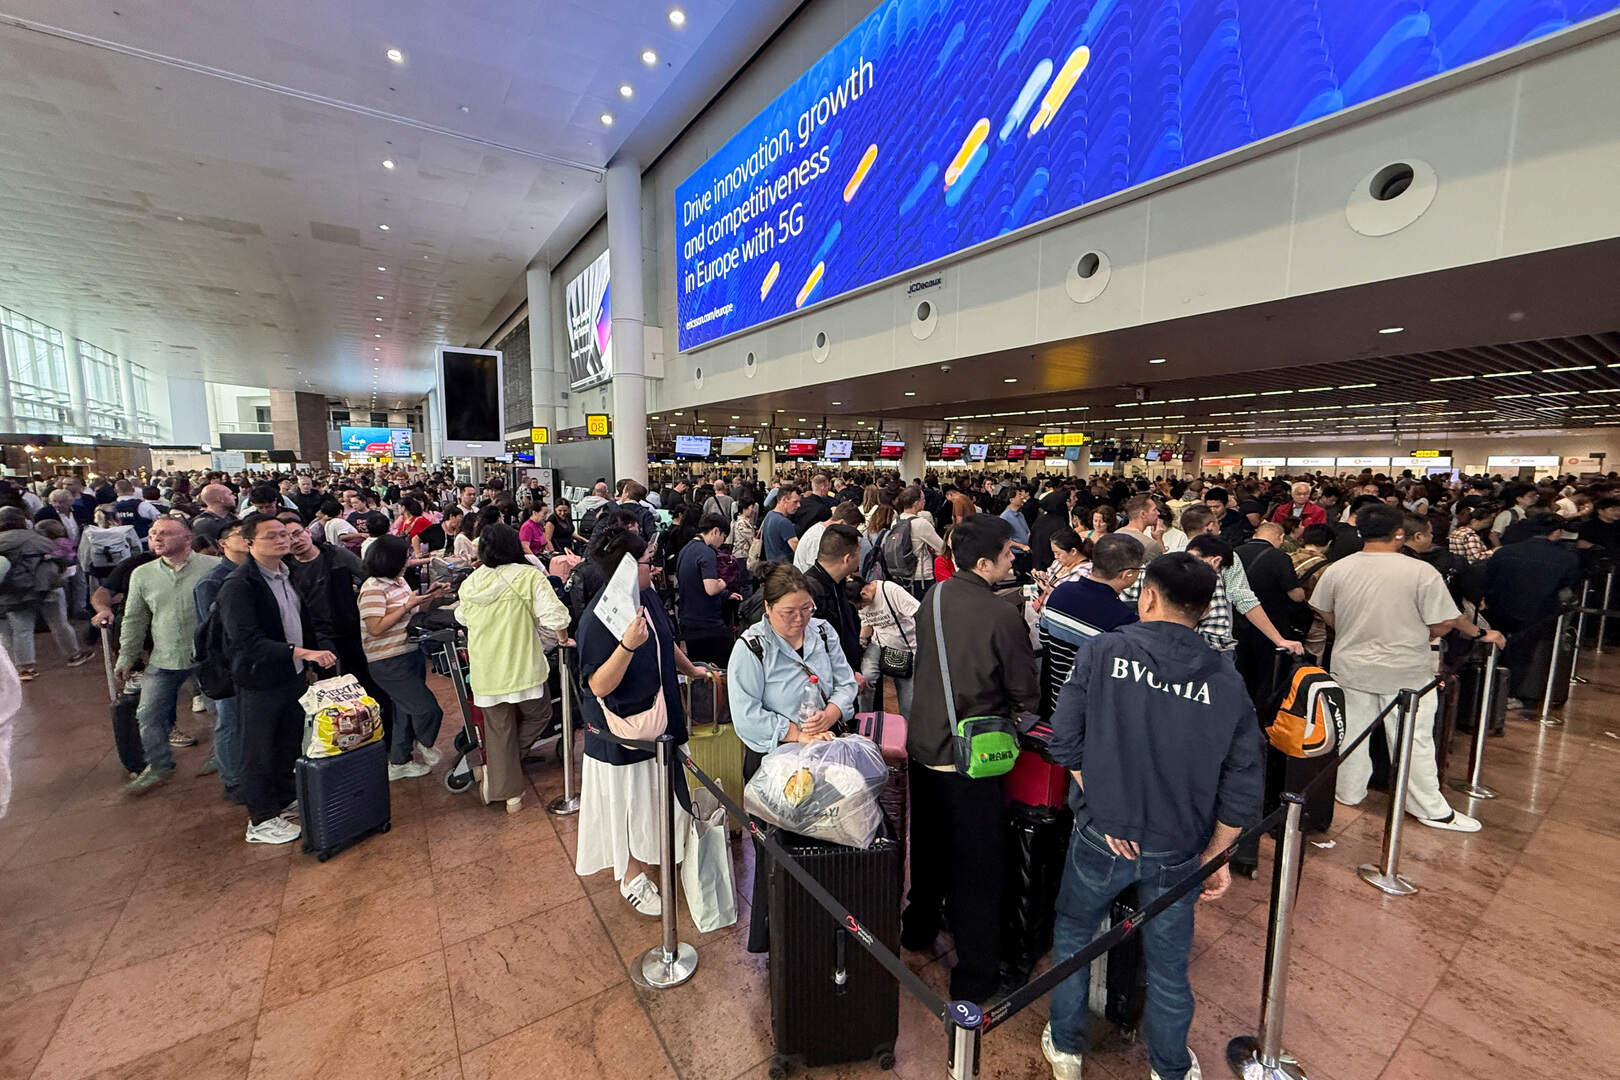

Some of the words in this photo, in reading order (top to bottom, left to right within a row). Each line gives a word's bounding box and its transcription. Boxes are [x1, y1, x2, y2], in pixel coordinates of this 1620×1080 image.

[683, 189, 712, 227] Drive
[713, 127, 795, 204] innovation,
[797, 55, 874, 148] growth
[683, 223, 705, 260] and
[706, 144, 830, 245] competitiveness
[684, 266, 696, 294] in
[696, 248, 739, 289] Europe
[741, 223, 774, 263] with
[778, 202, 804, 244] 5G
[533, 432, 545, 440] 07
[590, 422, 605, 433] 08
